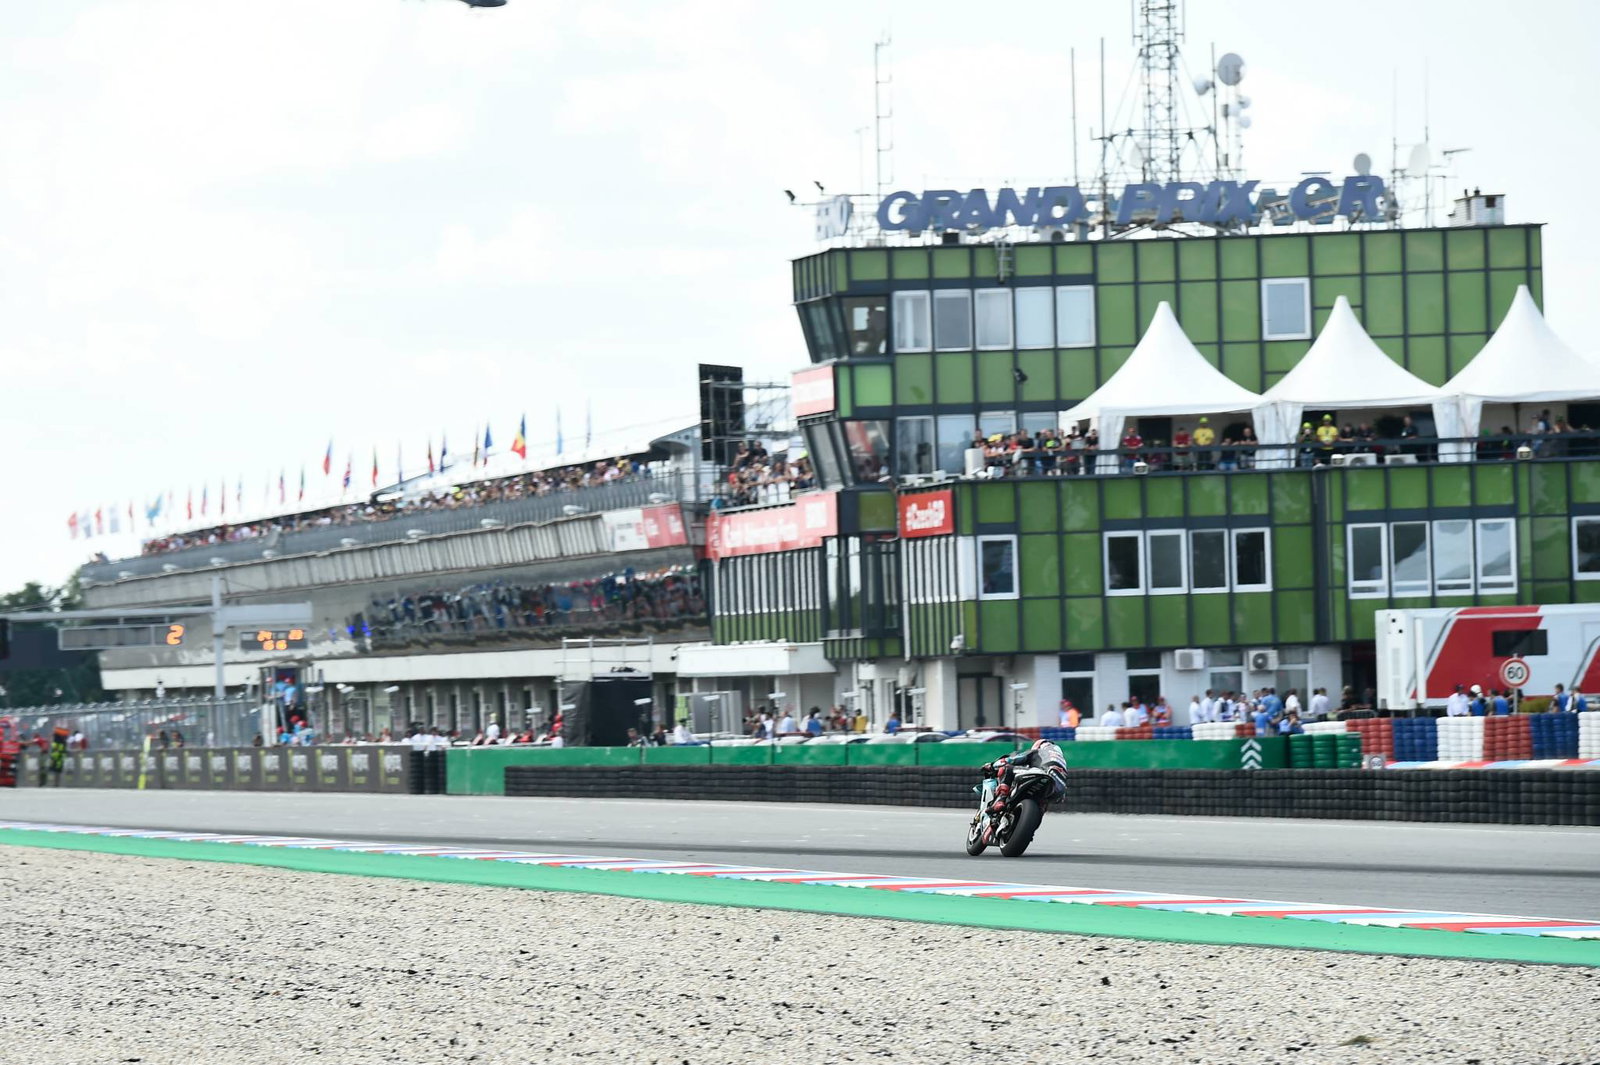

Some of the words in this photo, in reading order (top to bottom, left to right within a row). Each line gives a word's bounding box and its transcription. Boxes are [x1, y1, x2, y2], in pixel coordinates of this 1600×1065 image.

[877, 186, 1085, 231] GRAND
[1116, 180, 1261, 225] PRIX
[1507, 666, 1524, 680] 60
